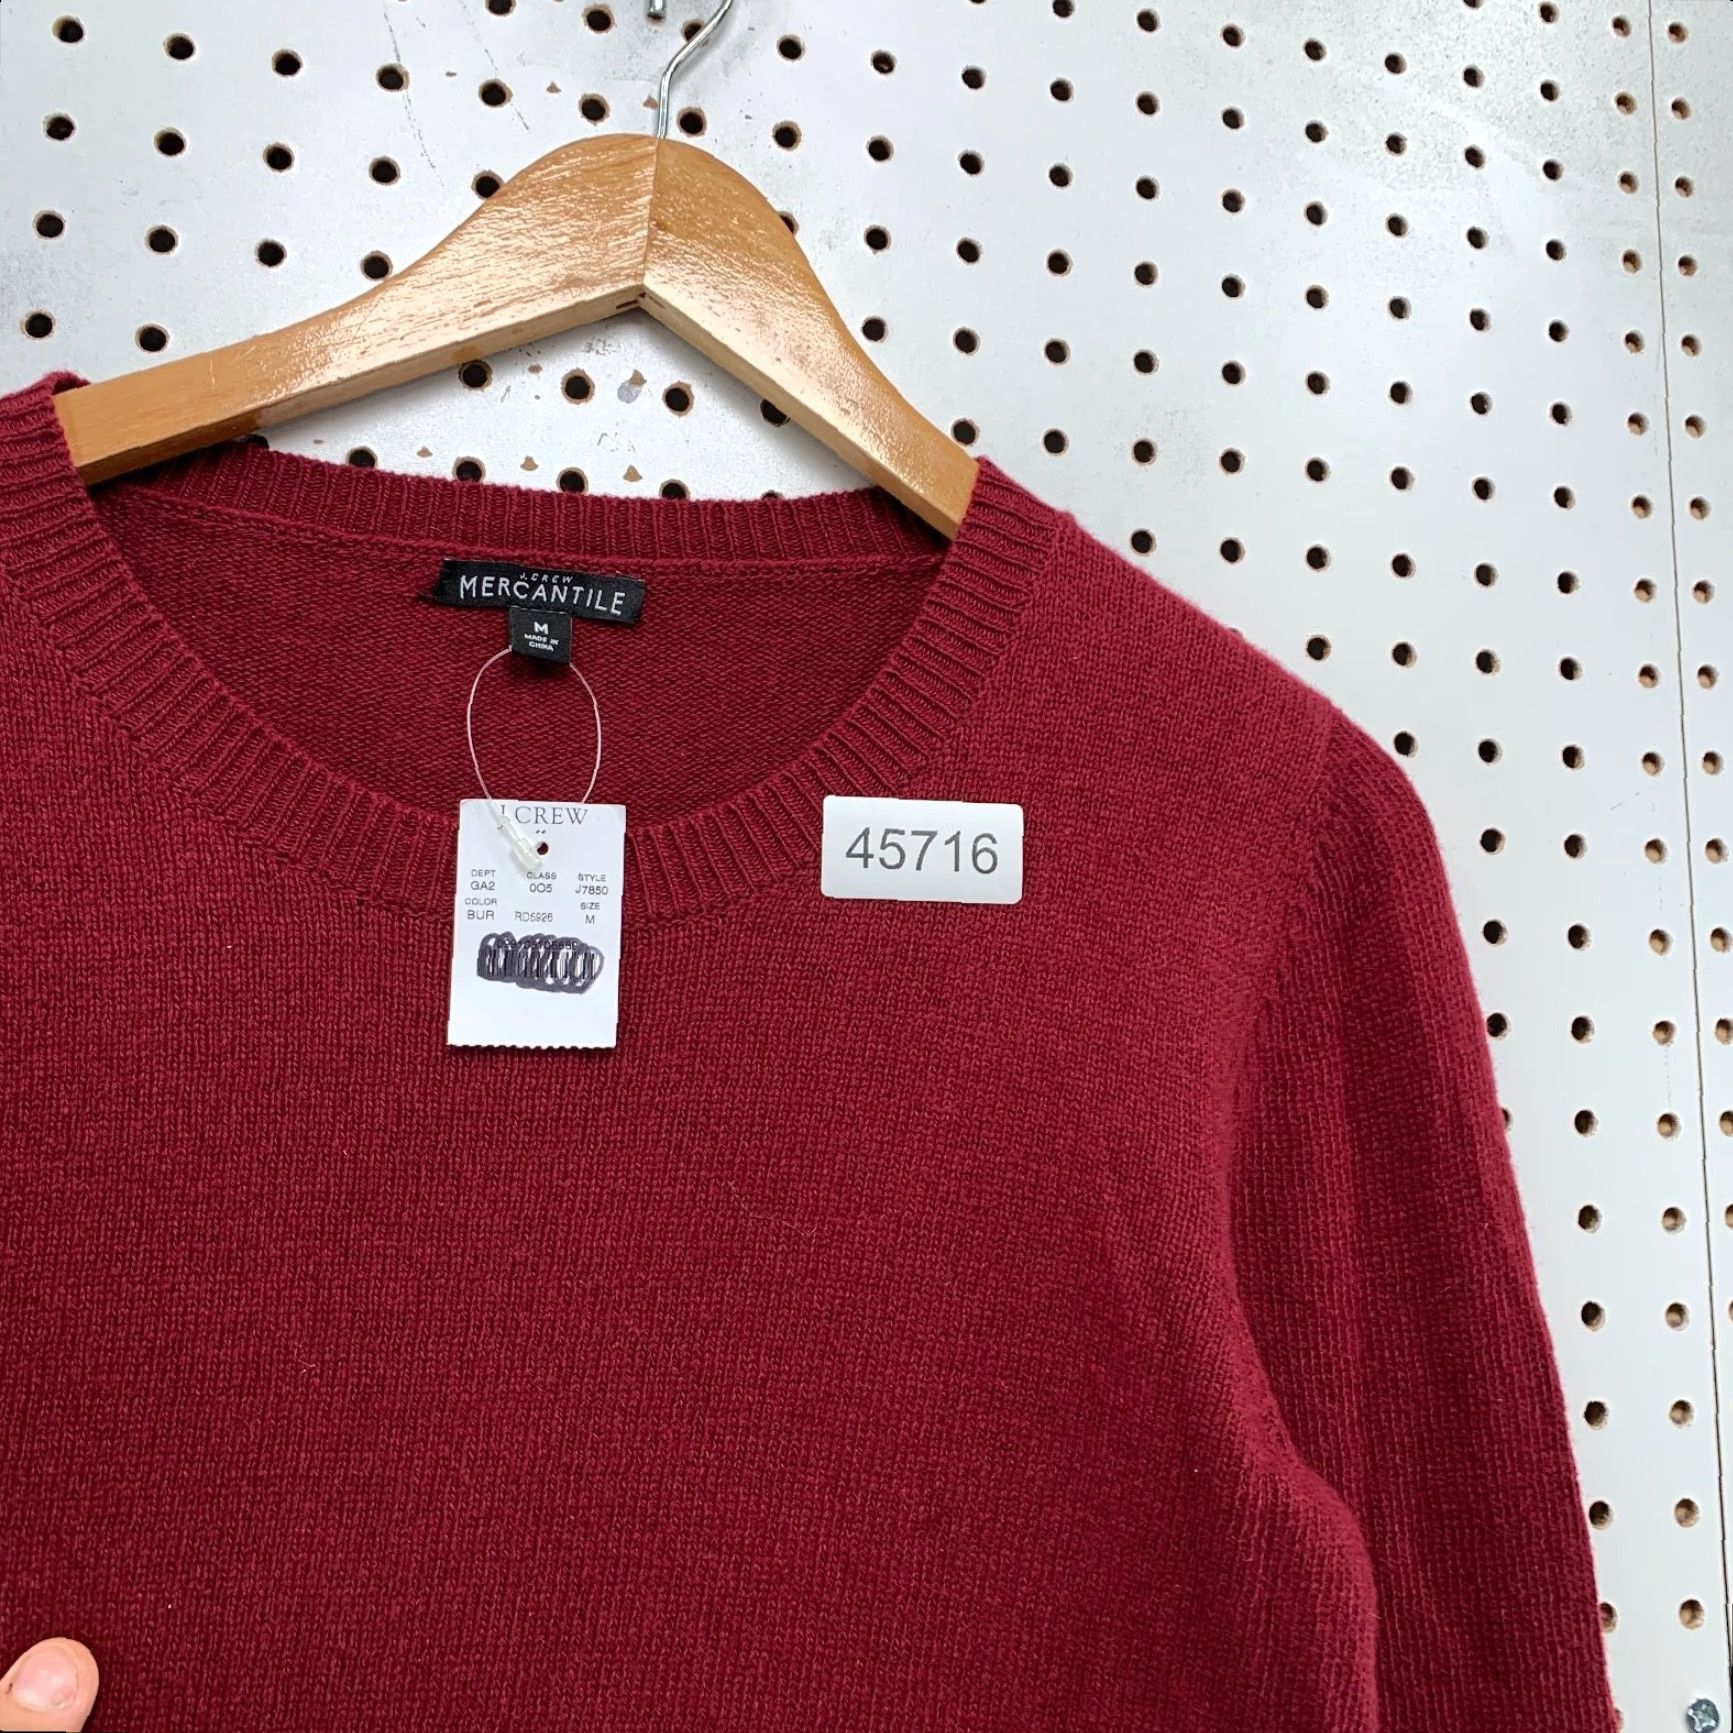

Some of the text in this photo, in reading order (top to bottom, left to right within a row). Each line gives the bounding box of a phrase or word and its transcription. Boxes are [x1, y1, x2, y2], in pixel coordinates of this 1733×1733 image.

[458, 574, 627, 616] MERCANTILE
[533, 620, 549, 635] M
[524, 633, 548, 643] MADE
[528, 640, 554, 652] CHINA
[845, 826, 999, 875] 45716
[471, 869, 607, 882] DEPT CLASS STYLE
[470, 880, 496, 891] GA2
[574, 884, 609, 896] J7850
[464, 897, 601, 911] COLOR SIZE
[466, 909, 495, 921] BUR
[585, 915, 596, 925] M
